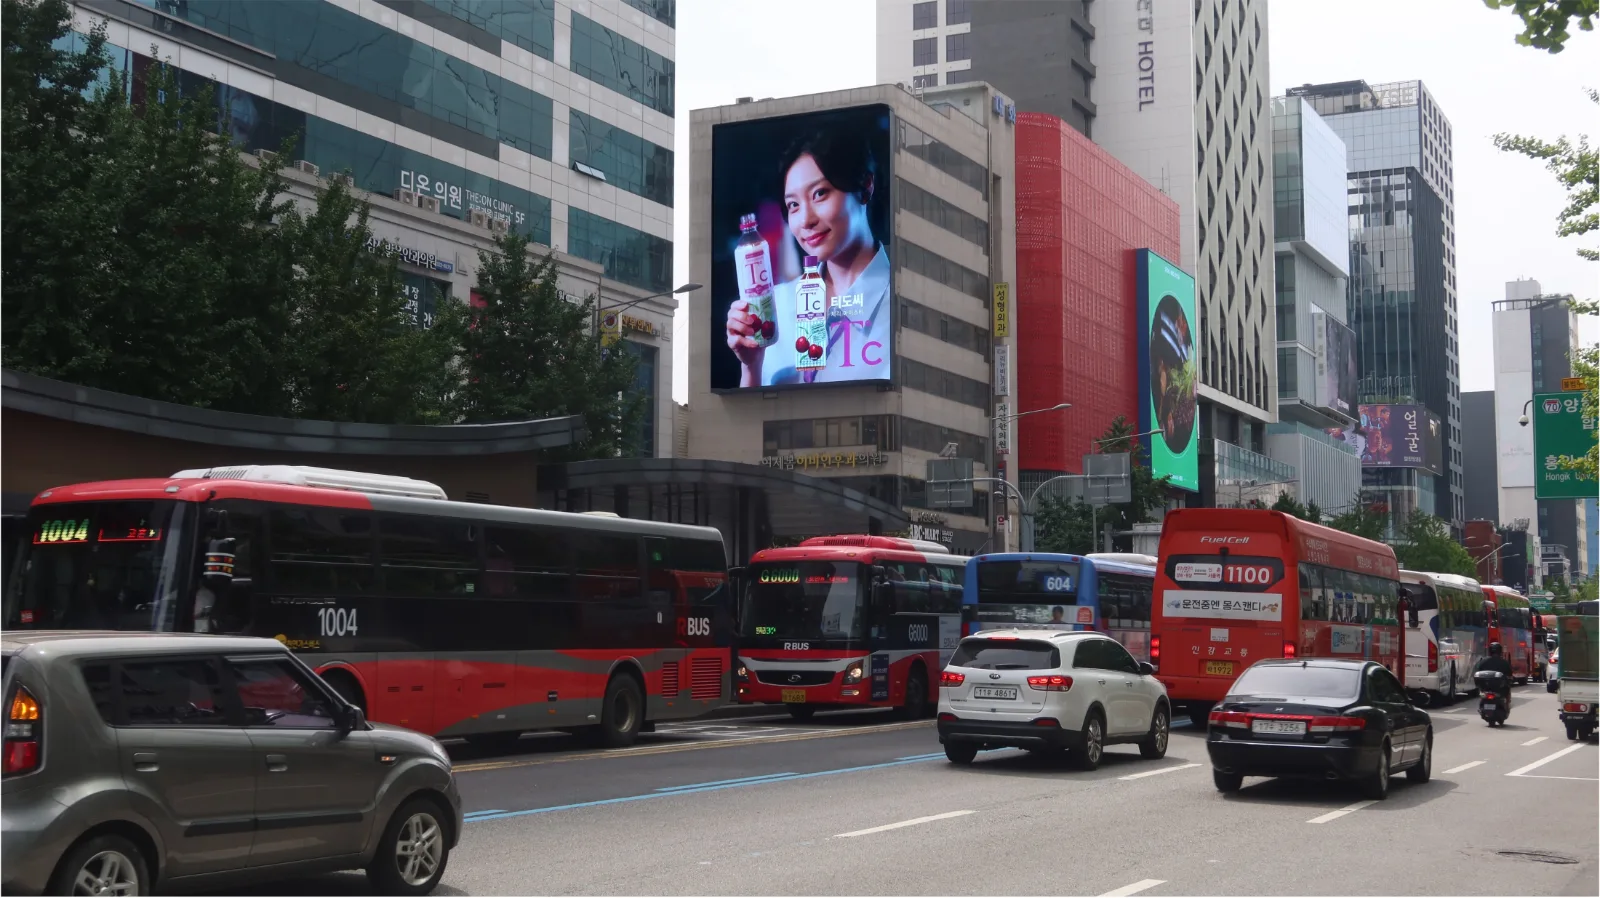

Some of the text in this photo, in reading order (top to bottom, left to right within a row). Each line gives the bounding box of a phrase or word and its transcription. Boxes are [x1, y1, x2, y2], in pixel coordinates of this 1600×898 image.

[1138, 41, 1154, 112] HOTEL
[401, 170, 461, 210] 디온 의원
[515, 211, 525, 225] 5F
[830, 293, 863, 308] 티도씨
[997, 290, 1006, 332] 성형외과
[1546, 403, 1557, 411] 70
[1404, 410, 1420, 453] 얼굴
[1545, 472, 1571, 482] Hongik
[40, 519, 89, 543] 1004
[1200, 536, 1250, 544] Fuel Cell
[1227, 566, 1270, 584] 1100
[1046, 576, 1072, 591] 604
[1182, 599, 1262, 612] 운전중엔 몽스캔디
[318, 607, 358, 637] 1004
